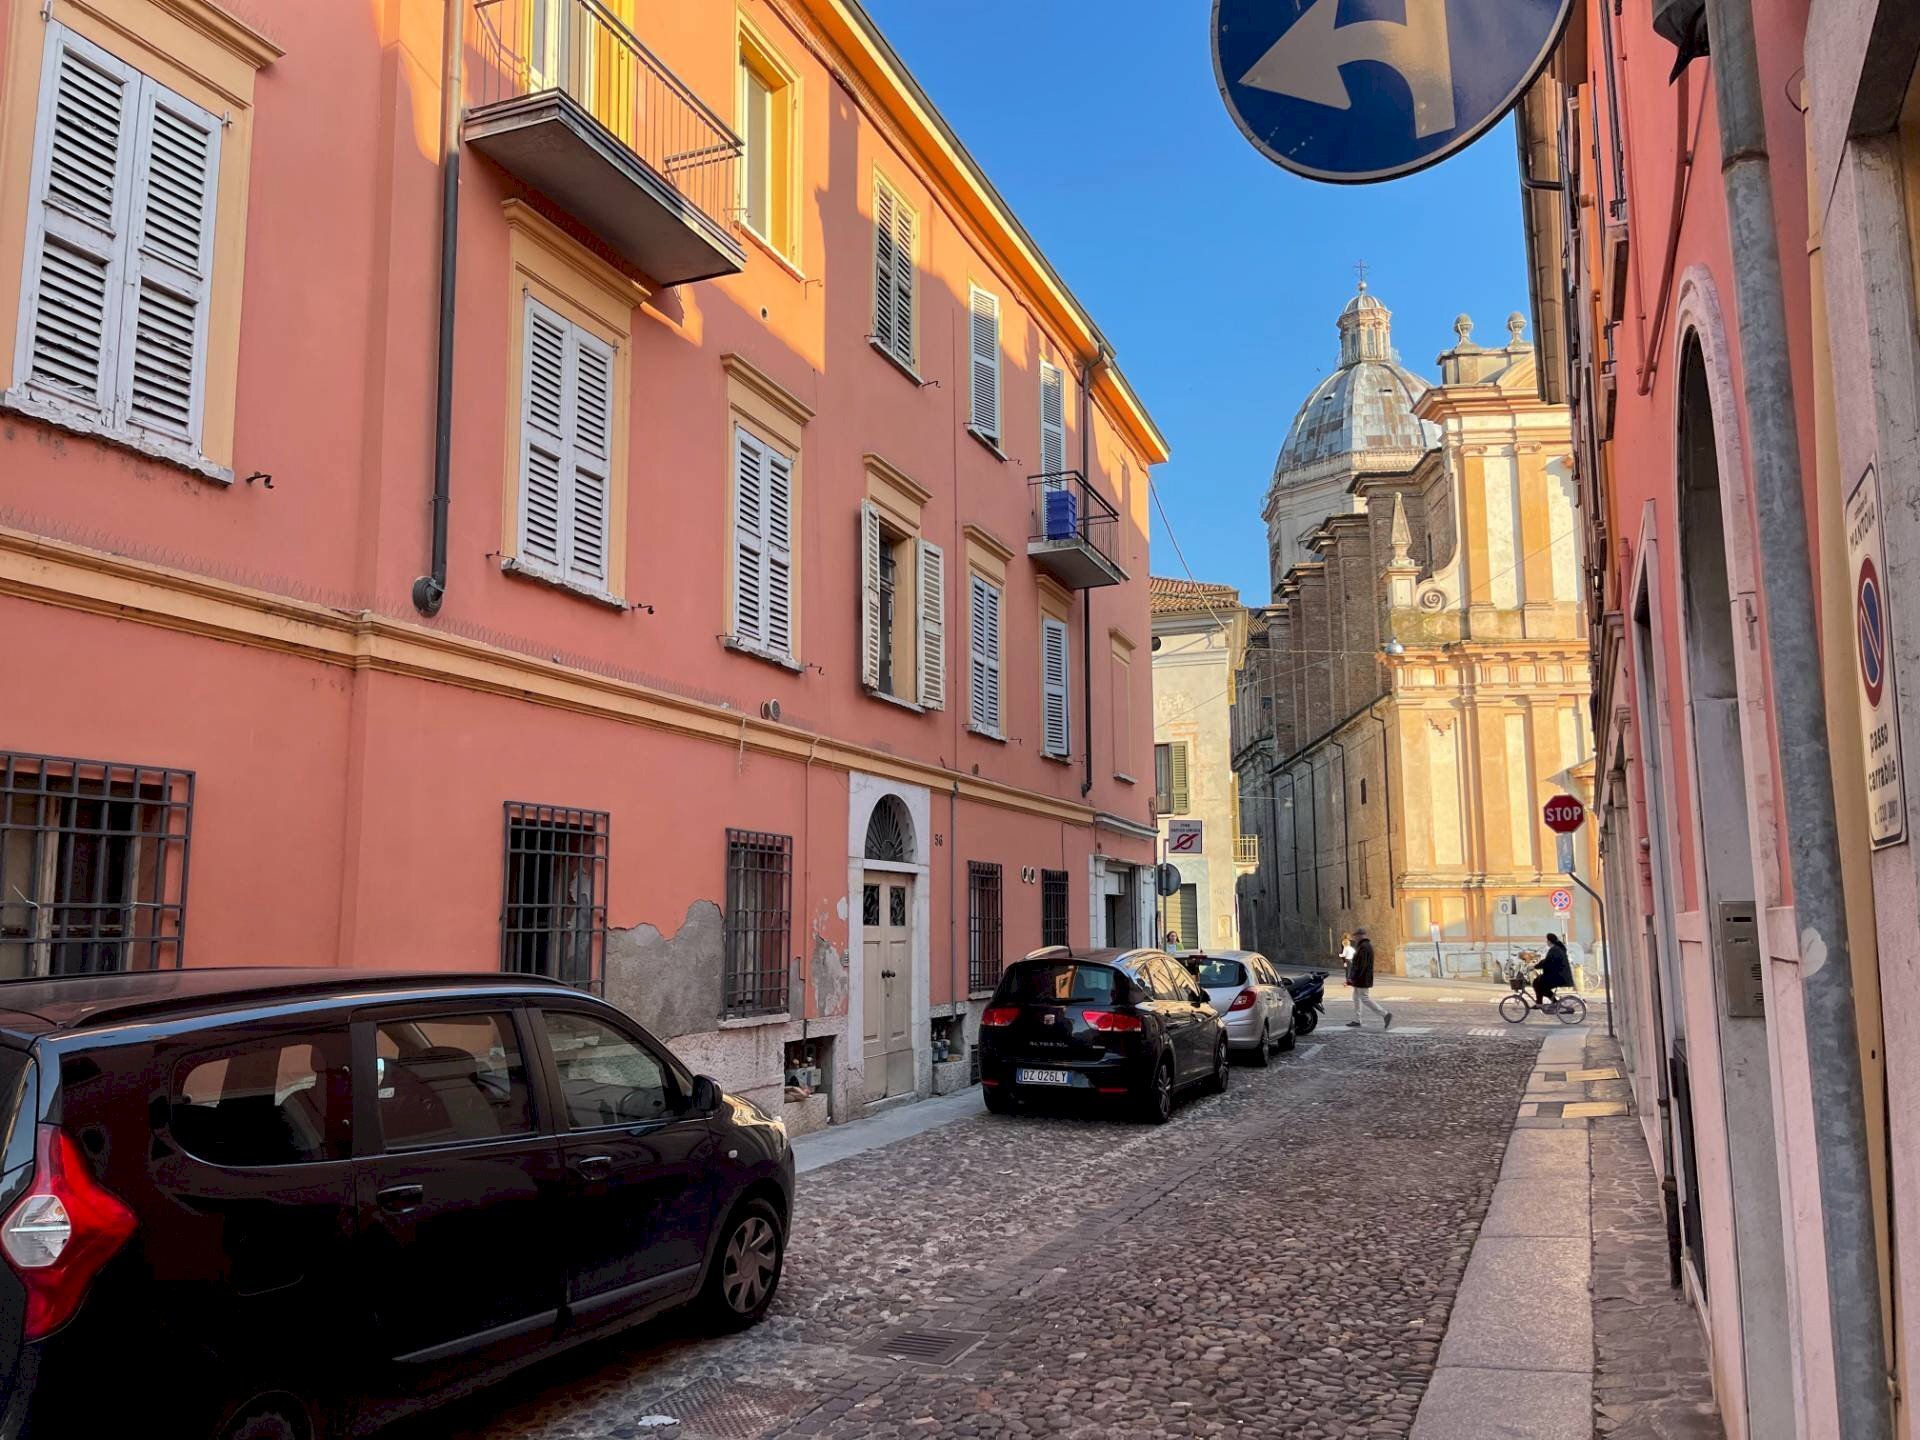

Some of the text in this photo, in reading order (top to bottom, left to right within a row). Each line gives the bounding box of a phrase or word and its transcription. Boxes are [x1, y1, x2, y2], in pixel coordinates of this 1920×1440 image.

[1850, 501, 1876, 555] MANTOVA
[1868, 722, 1889, 758] passo
[1868, 754, 1897, 793] carrabile
[1545, 806, 1582, 822] STOP
[934, 833, 943, 847] 56
[1023, 1070, 1067, 1083] DZ 026LY
